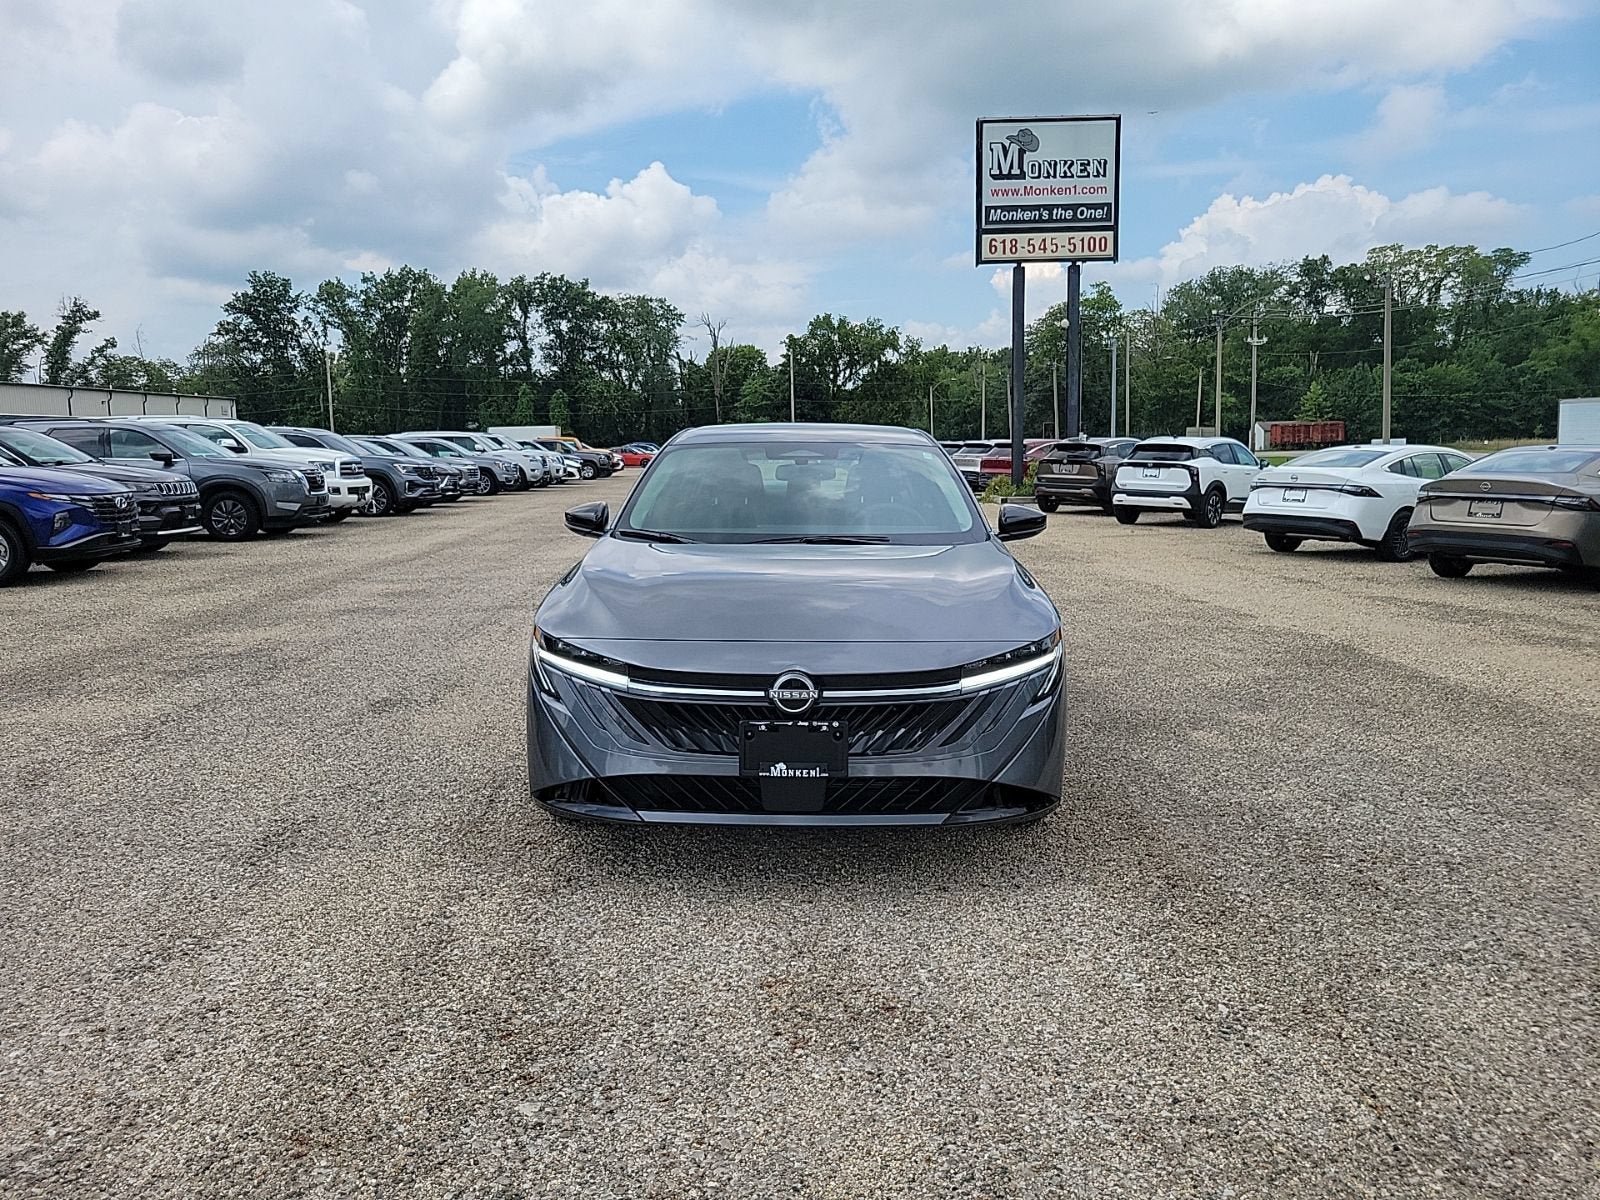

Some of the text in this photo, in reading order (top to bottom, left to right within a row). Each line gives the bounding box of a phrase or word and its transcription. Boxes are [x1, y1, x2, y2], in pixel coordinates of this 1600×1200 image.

[989, 142, 1107, 180] MONKEN
[990, 185, 1107, 197] www.Monken1.com
[989, 206, 1107, 222] Monken's the One!
[988, 236, 1108, 255] 618-545-5100
[770, 690, 818, 699] NISSAN
